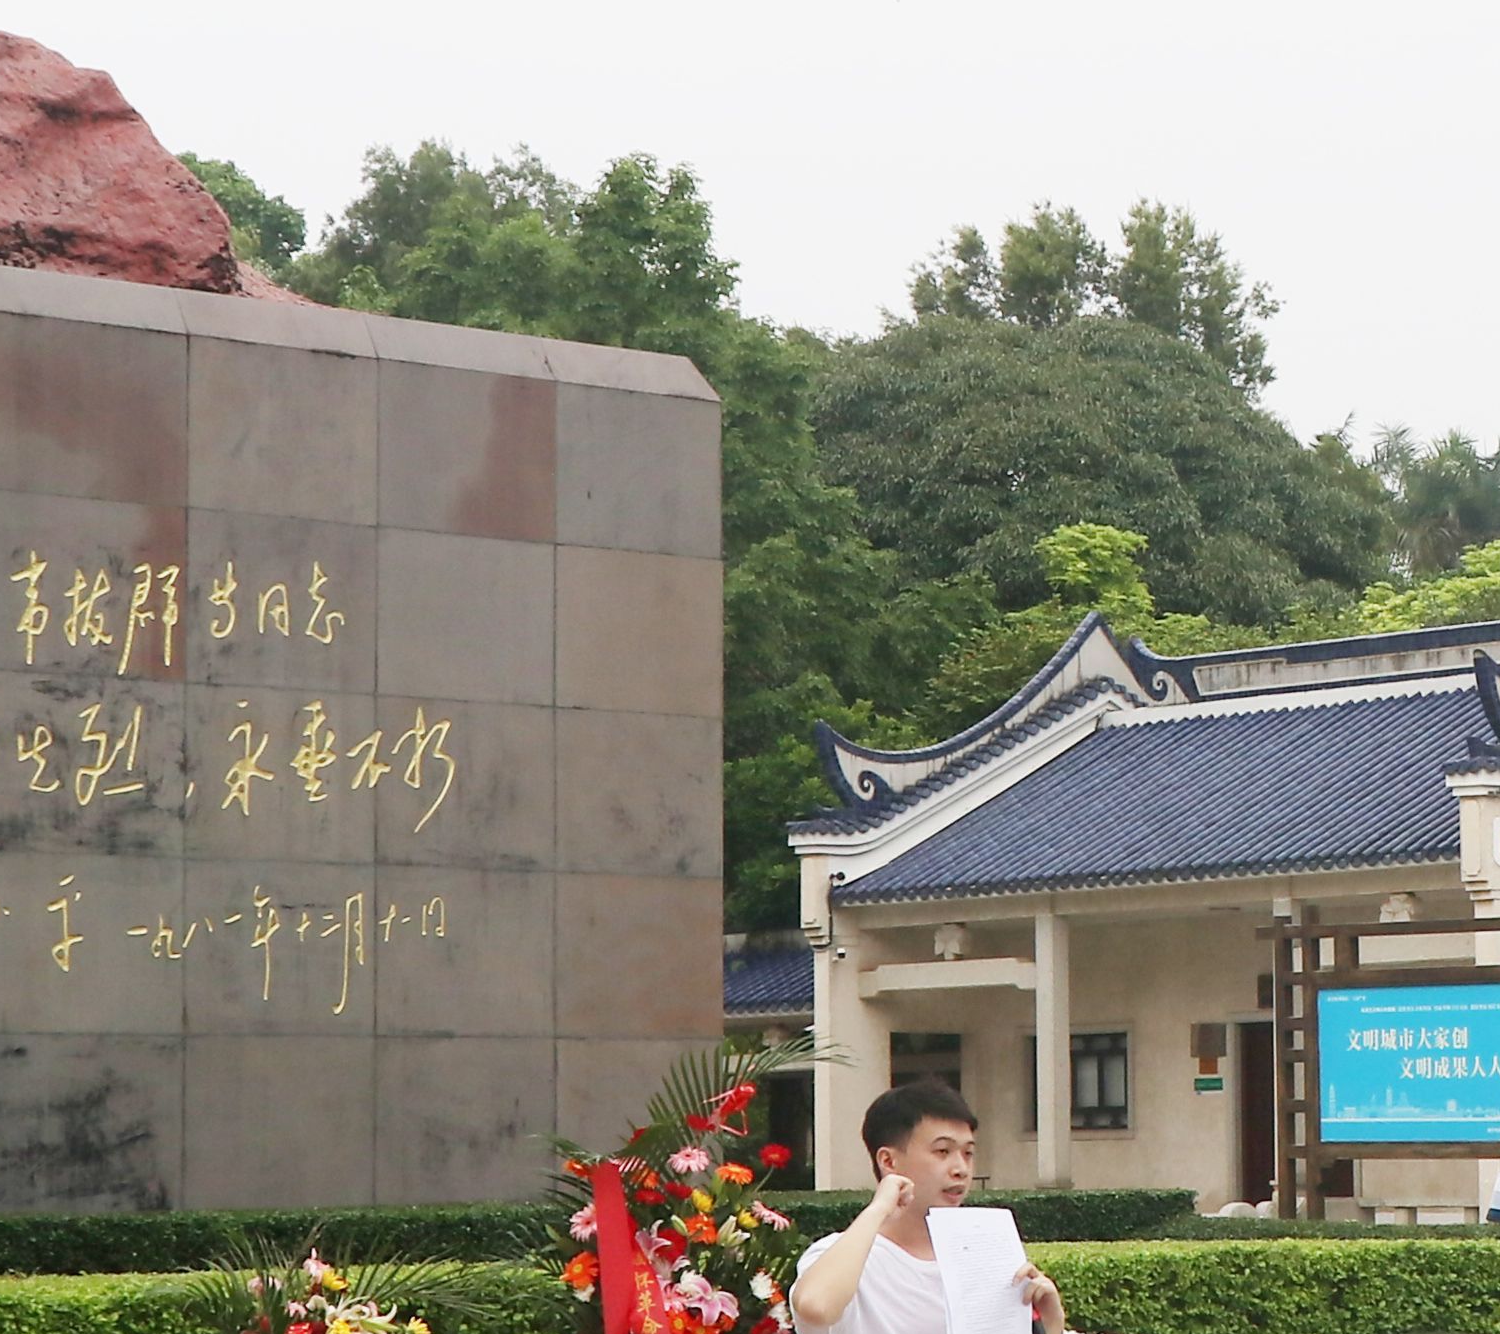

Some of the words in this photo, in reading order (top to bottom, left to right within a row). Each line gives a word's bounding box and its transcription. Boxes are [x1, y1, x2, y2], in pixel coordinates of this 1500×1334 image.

[1346, 1026, 1469, 1052] 文明城市大家创
